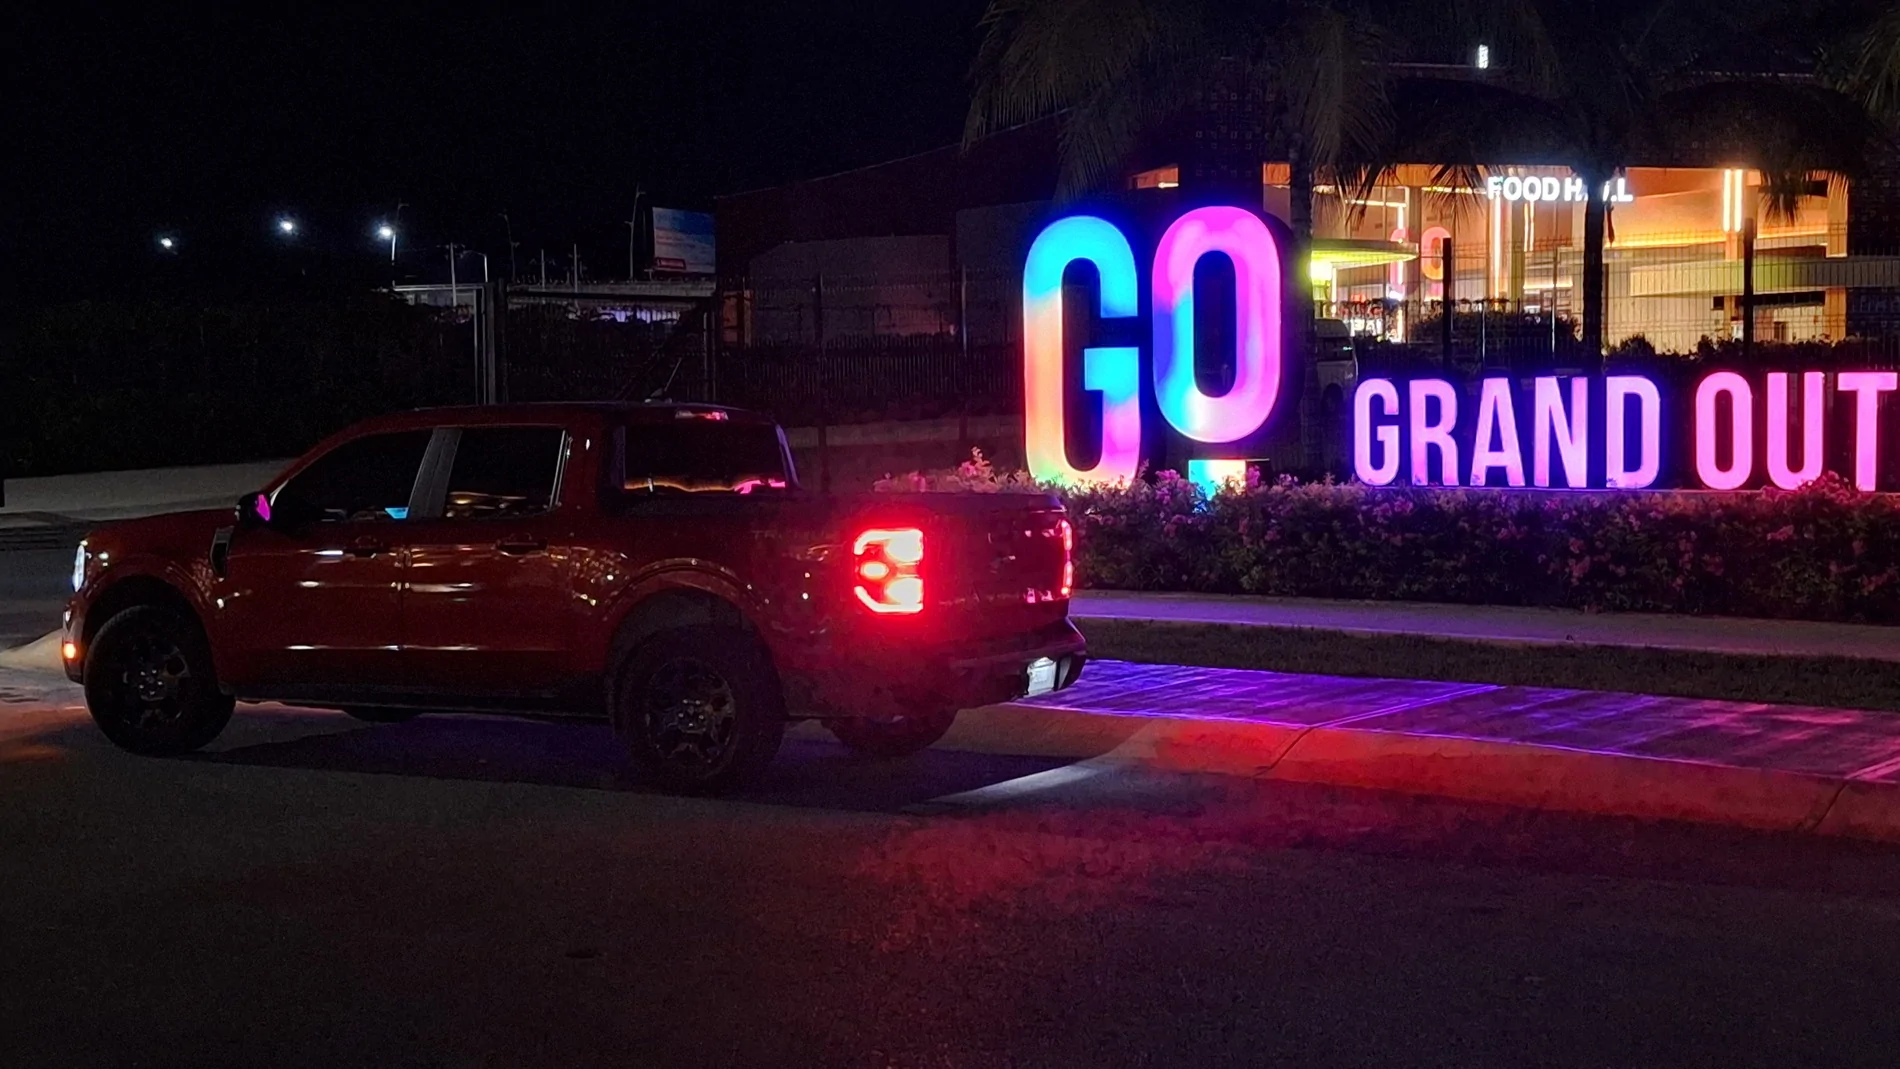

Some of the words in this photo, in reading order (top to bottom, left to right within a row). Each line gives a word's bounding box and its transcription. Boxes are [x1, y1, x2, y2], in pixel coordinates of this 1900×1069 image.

[1486, 176, 1560, 201] FOOD
[1563, 176, 1634, 202] HLL
[1023, 205, 1281, 490] GO
[1354, 375, 1661, 488] GRAND
[1695, 371, 1899, 491] OUT
